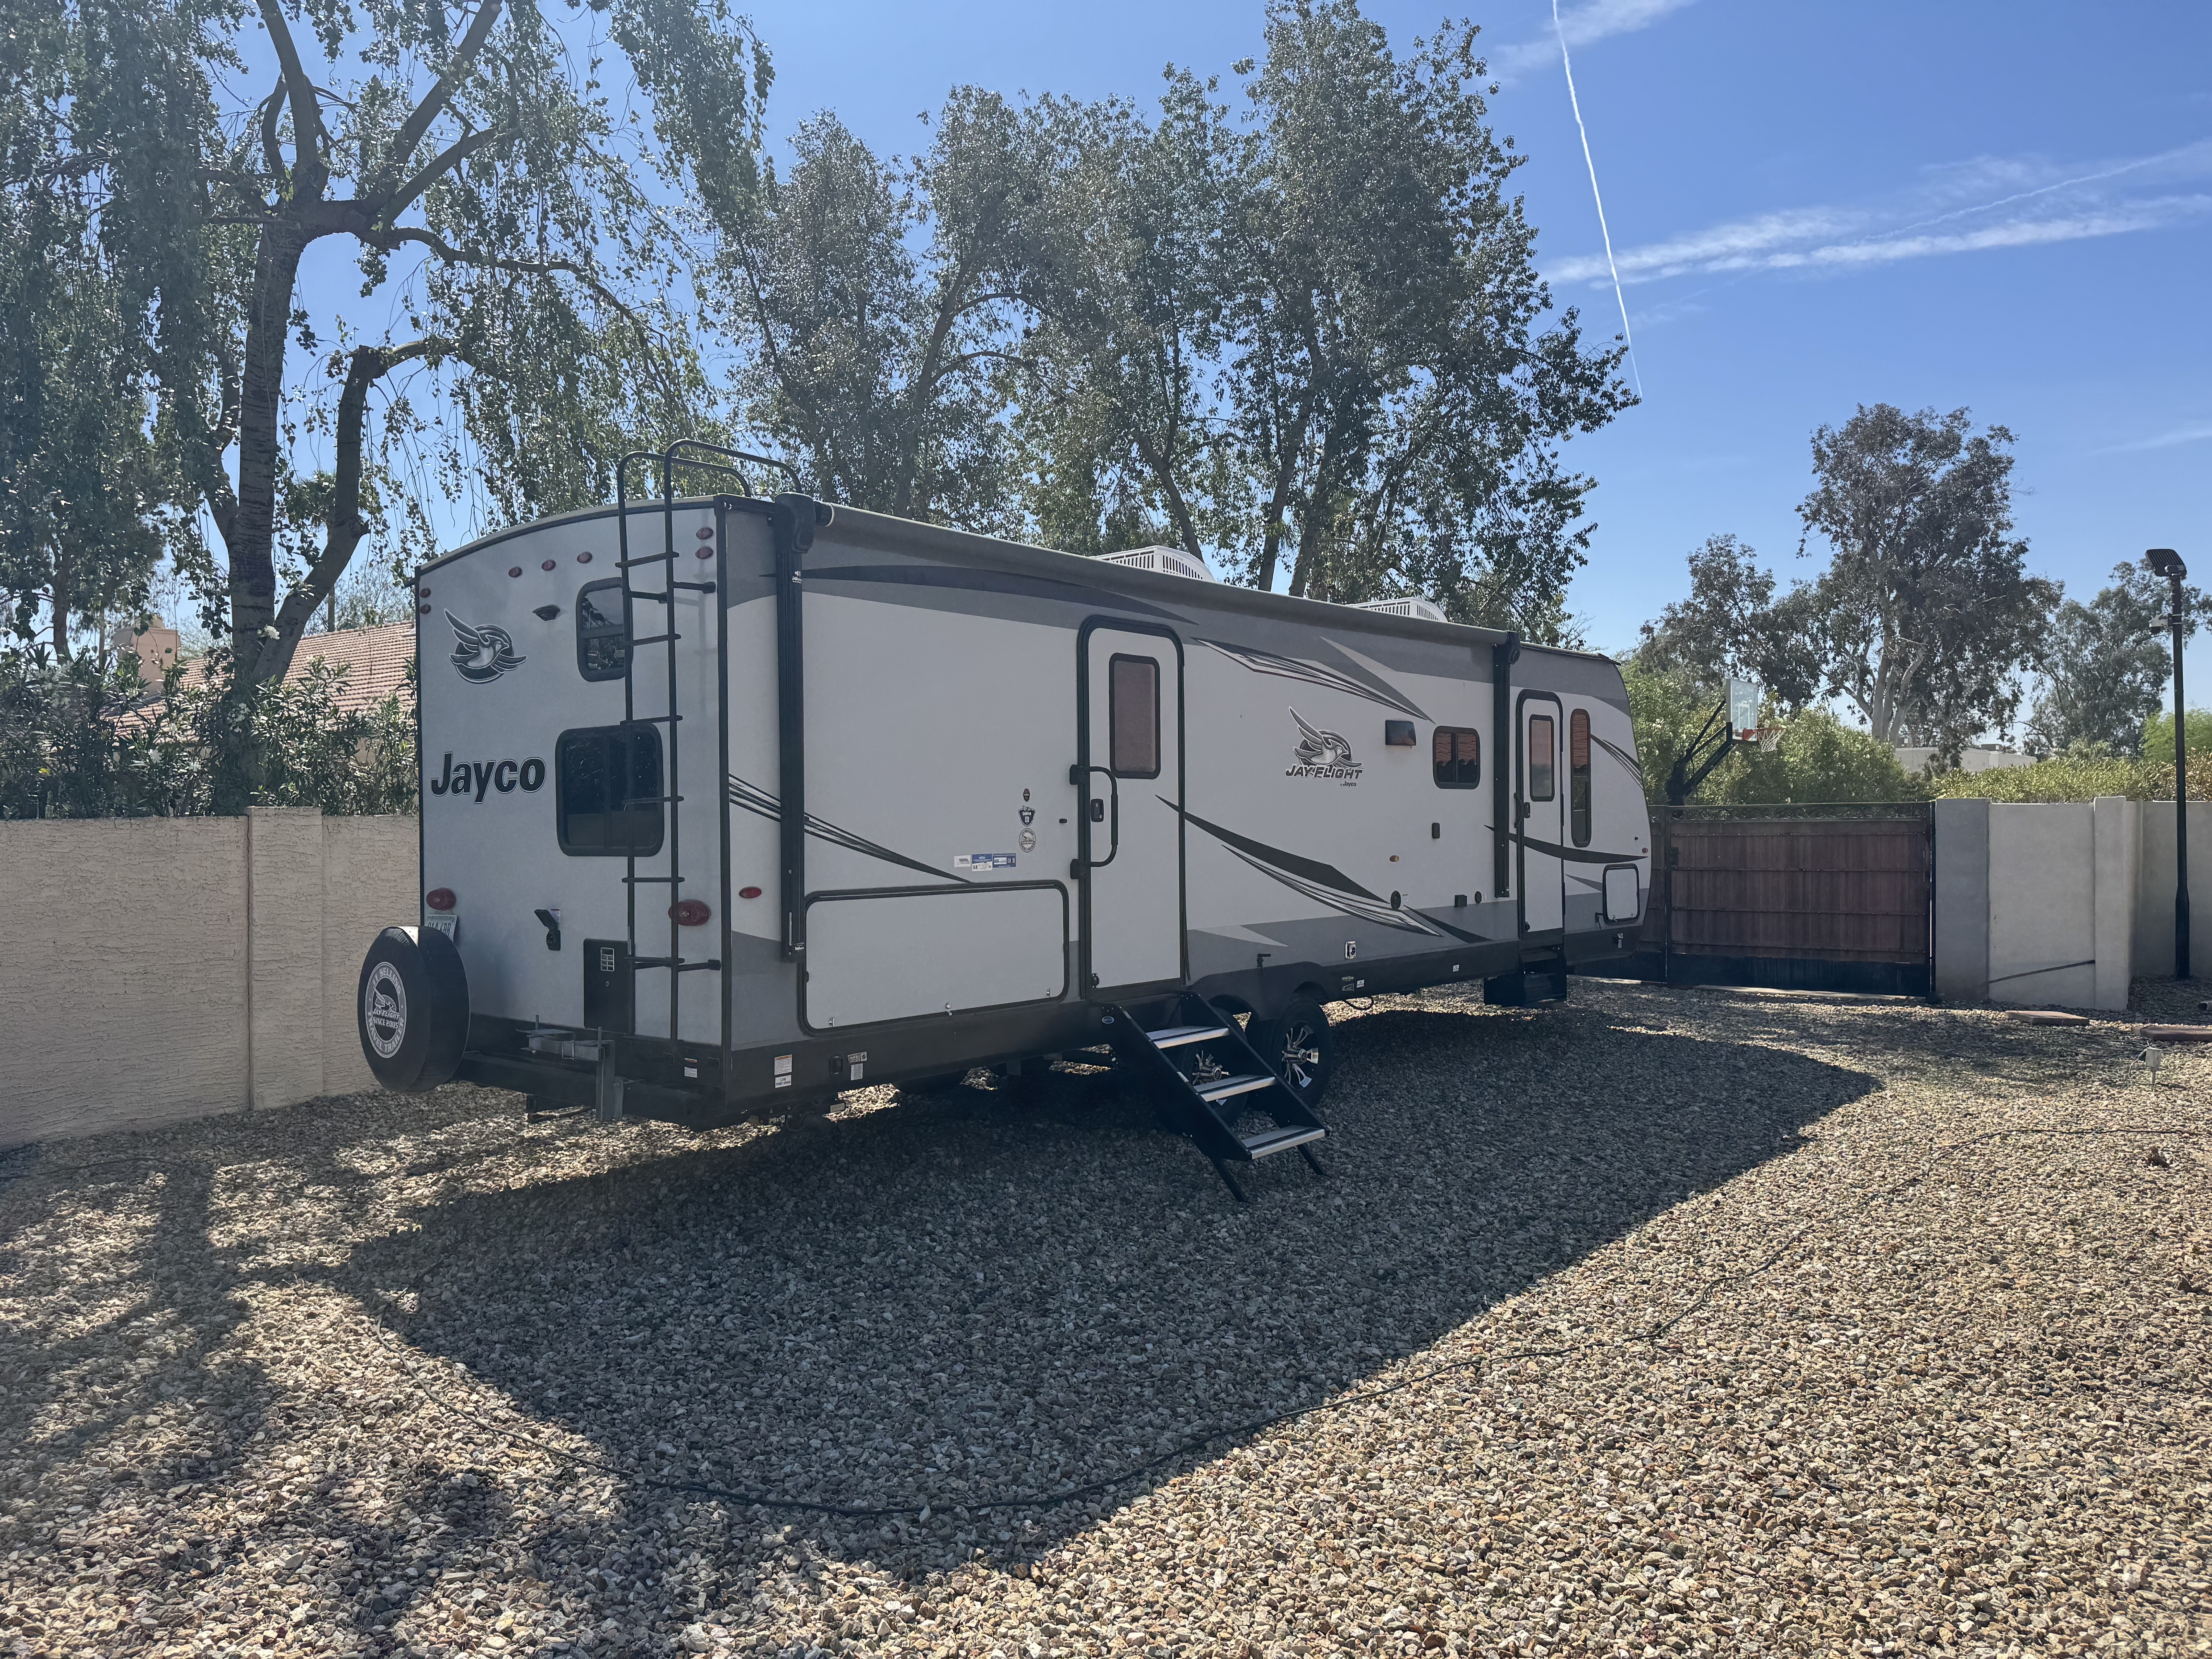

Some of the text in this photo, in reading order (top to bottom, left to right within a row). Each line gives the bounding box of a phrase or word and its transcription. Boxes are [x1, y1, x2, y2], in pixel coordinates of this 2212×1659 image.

[430, 751, 546, 804] Jayco
[379, 967, 402, 994] SELLING
[368, 1010, 404, 1052] TRAVEL TRAILER
[373, 1017, 398, 1029] SINCE 2005
